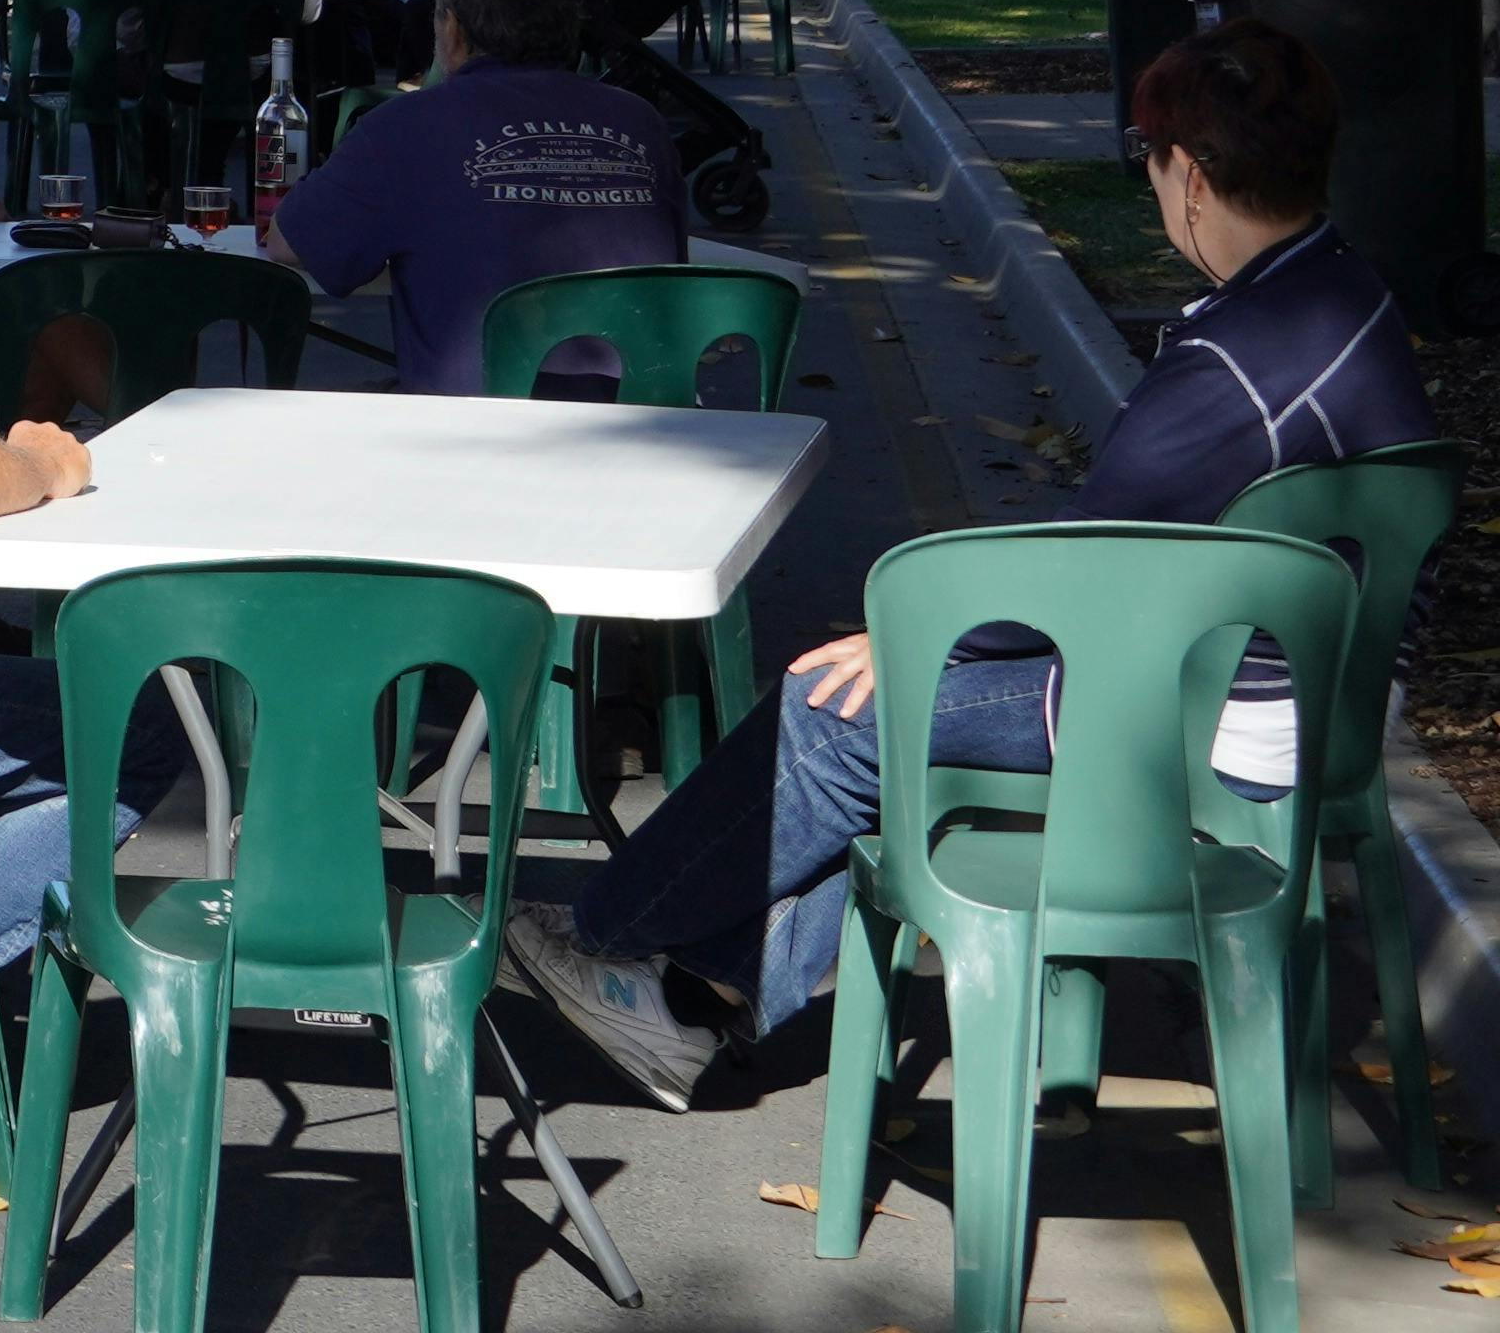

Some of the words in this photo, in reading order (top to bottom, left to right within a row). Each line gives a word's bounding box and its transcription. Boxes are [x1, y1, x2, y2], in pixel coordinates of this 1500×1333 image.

[502, 121, 647, 157] CHALMERS
[492, 185, 653, 204] IRONMONGERS
[304, 1010, 362, 1024] LIFETIME
